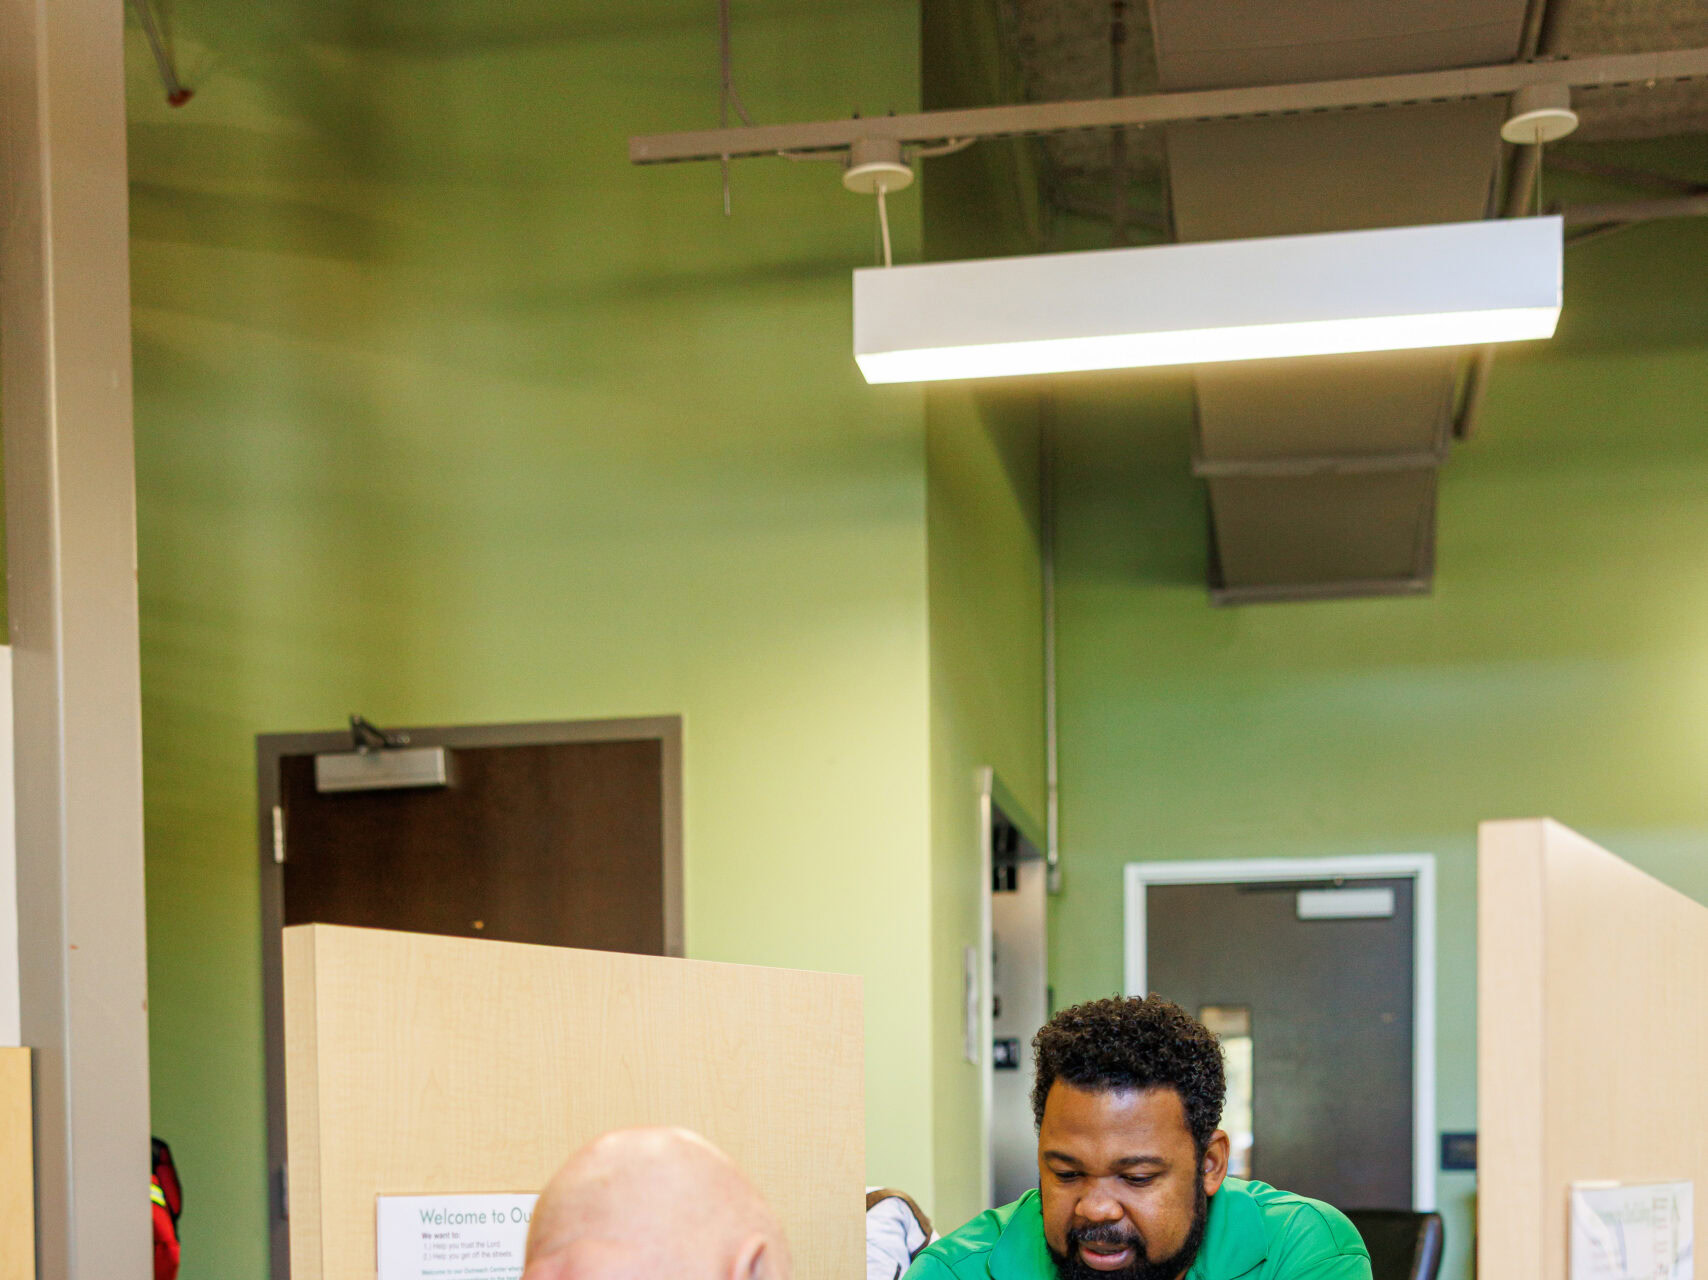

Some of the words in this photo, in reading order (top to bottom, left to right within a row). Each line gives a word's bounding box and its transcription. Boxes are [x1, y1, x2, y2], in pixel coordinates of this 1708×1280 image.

[419, 1207, 487, 1225] Welcome
[492, 1209, 506, 1224] to
[510, 1206, 532, 1224] Ou
[421, 1232, 432, 1240] We
[434, 1232, 450, 1240] want
[449, 1243, 460, 1251] you
[476, 1240, 485, 1248] the
[449, 1253, 460, 1262] you
[481, 1250, 491, 1258] the
